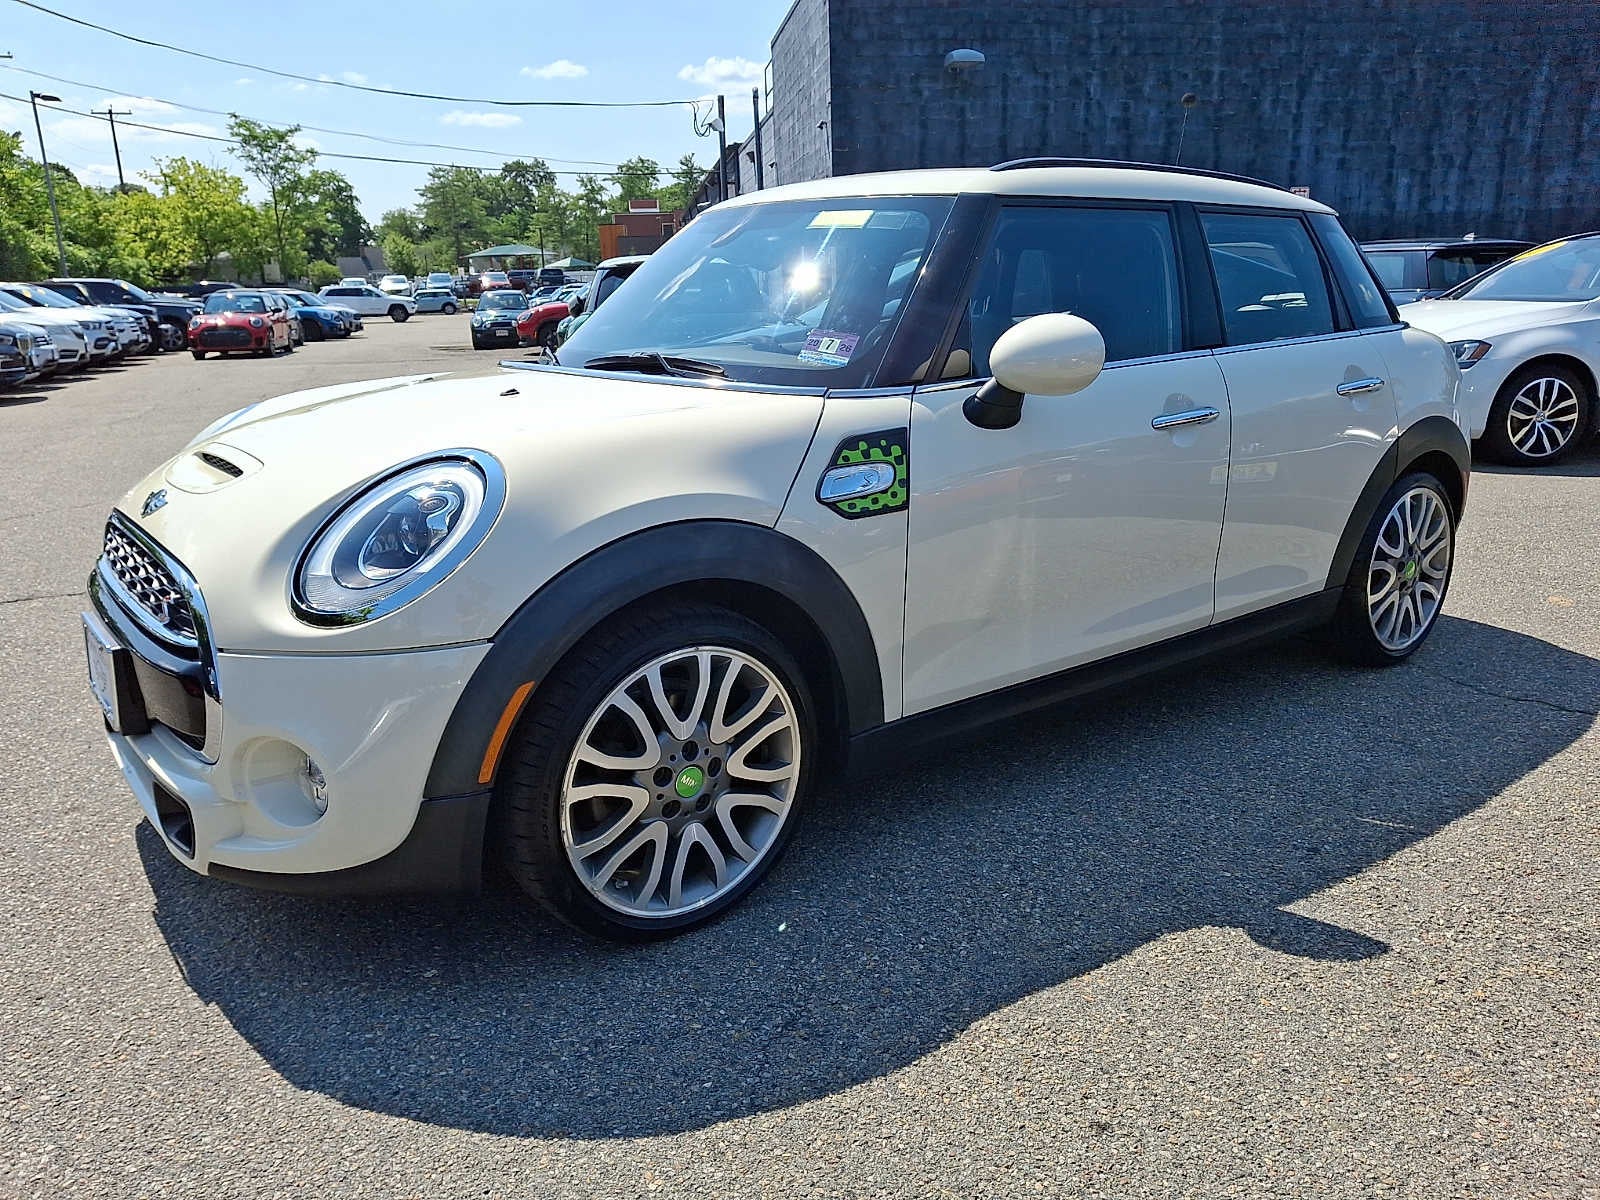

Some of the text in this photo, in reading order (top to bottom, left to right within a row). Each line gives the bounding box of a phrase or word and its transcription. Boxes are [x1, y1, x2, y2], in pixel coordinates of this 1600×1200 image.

[807, 338, 853, 353] 20 7 26
